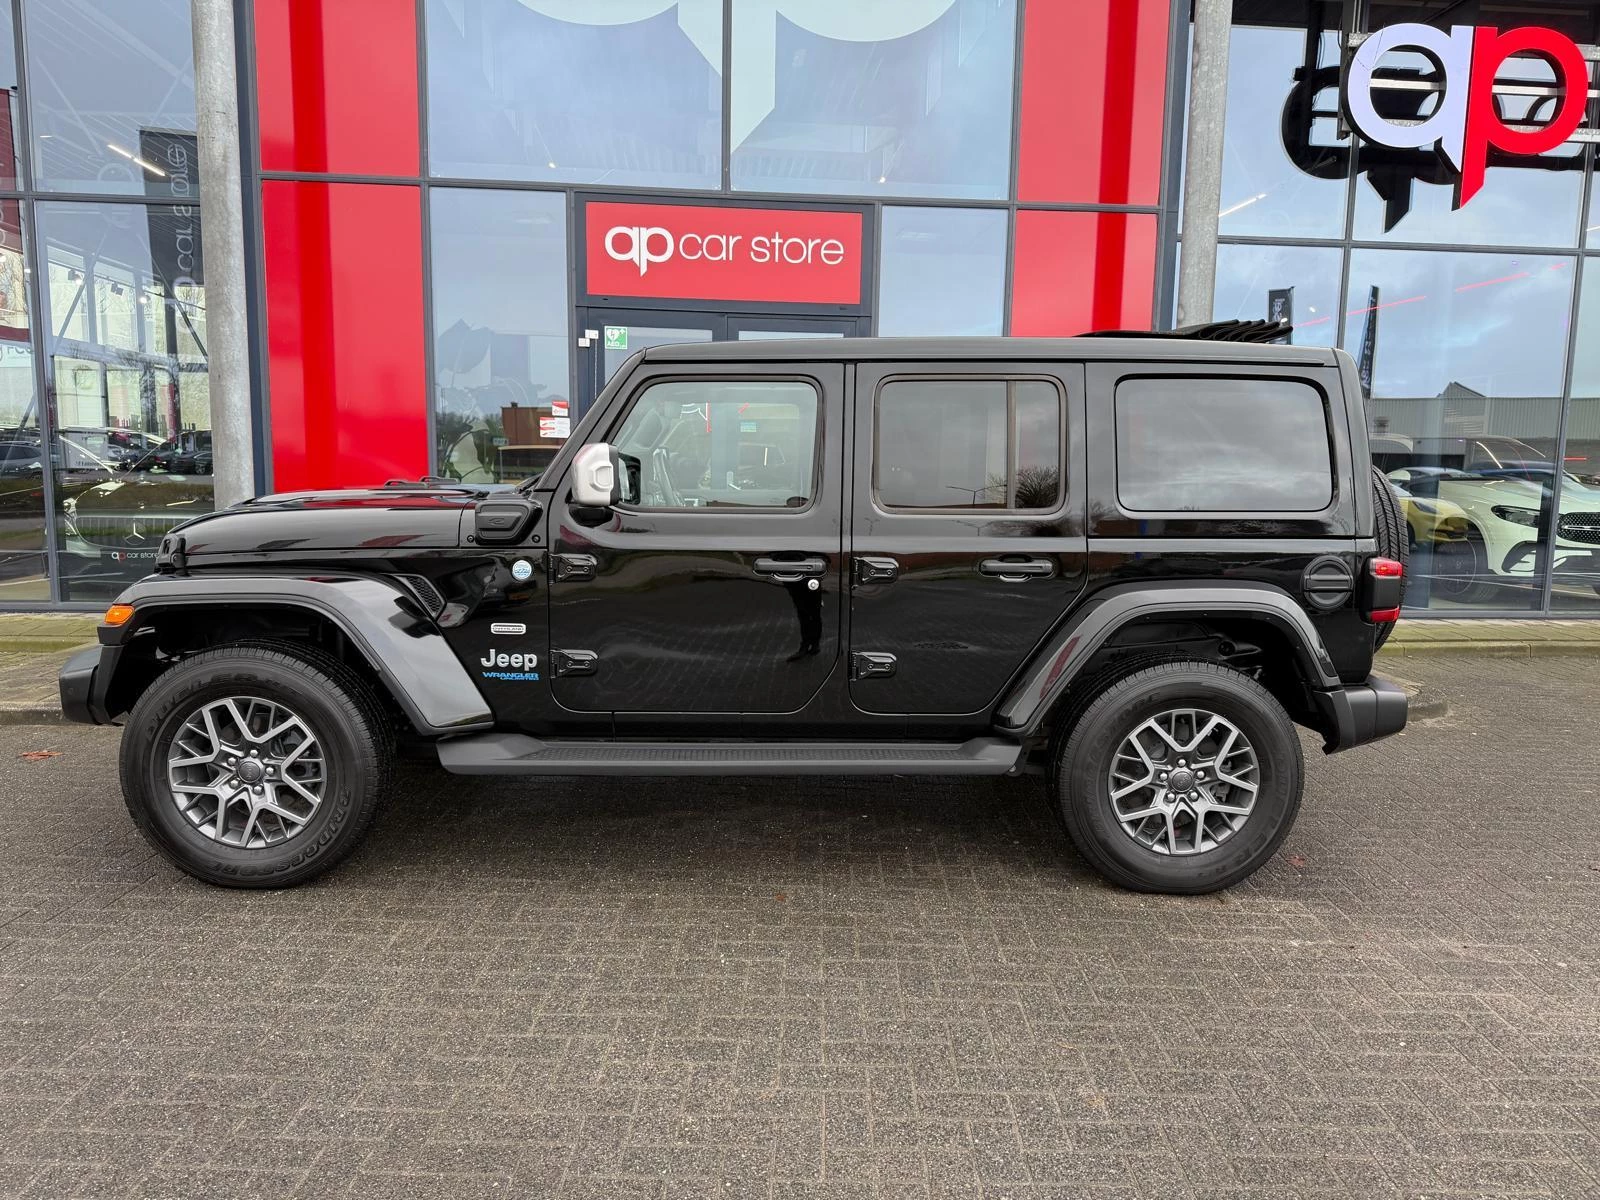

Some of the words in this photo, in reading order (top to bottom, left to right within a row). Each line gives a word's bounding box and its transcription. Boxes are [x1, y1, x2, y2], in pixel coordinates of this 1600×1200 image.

[1348, 23, 1588, 209] ap
[604, 226, 675, 278] ap
[679, 233, 742, 261] car
[750, 231, 844, 265] store
[481, 648, 538, 671] Jeep
